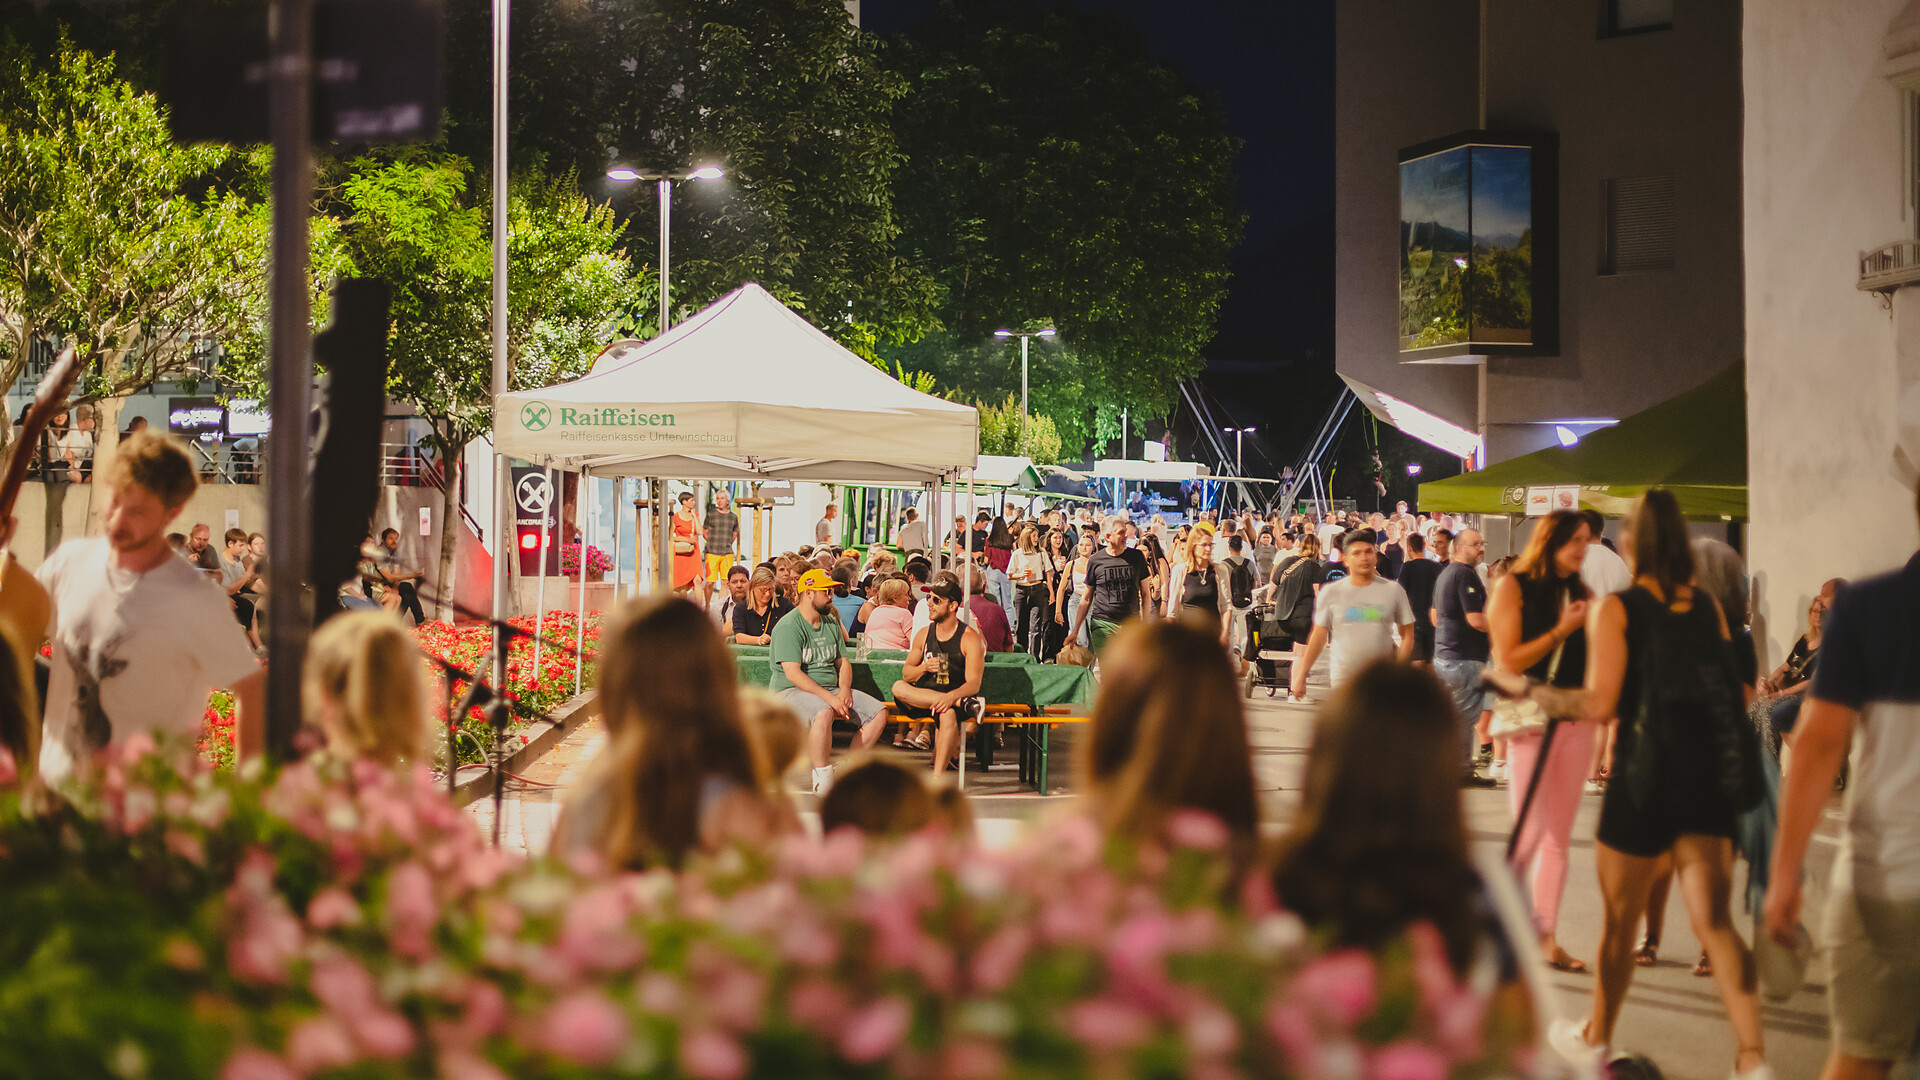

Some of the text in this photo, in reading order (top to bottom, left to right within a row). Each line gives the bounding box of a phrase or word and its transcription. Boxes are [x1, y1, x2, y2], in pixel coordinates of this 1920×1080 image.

[559, 407, 676, 426] Raiffeisen
[560, 431, 733, 445] Raiffeisenkasse Untervinschgau
